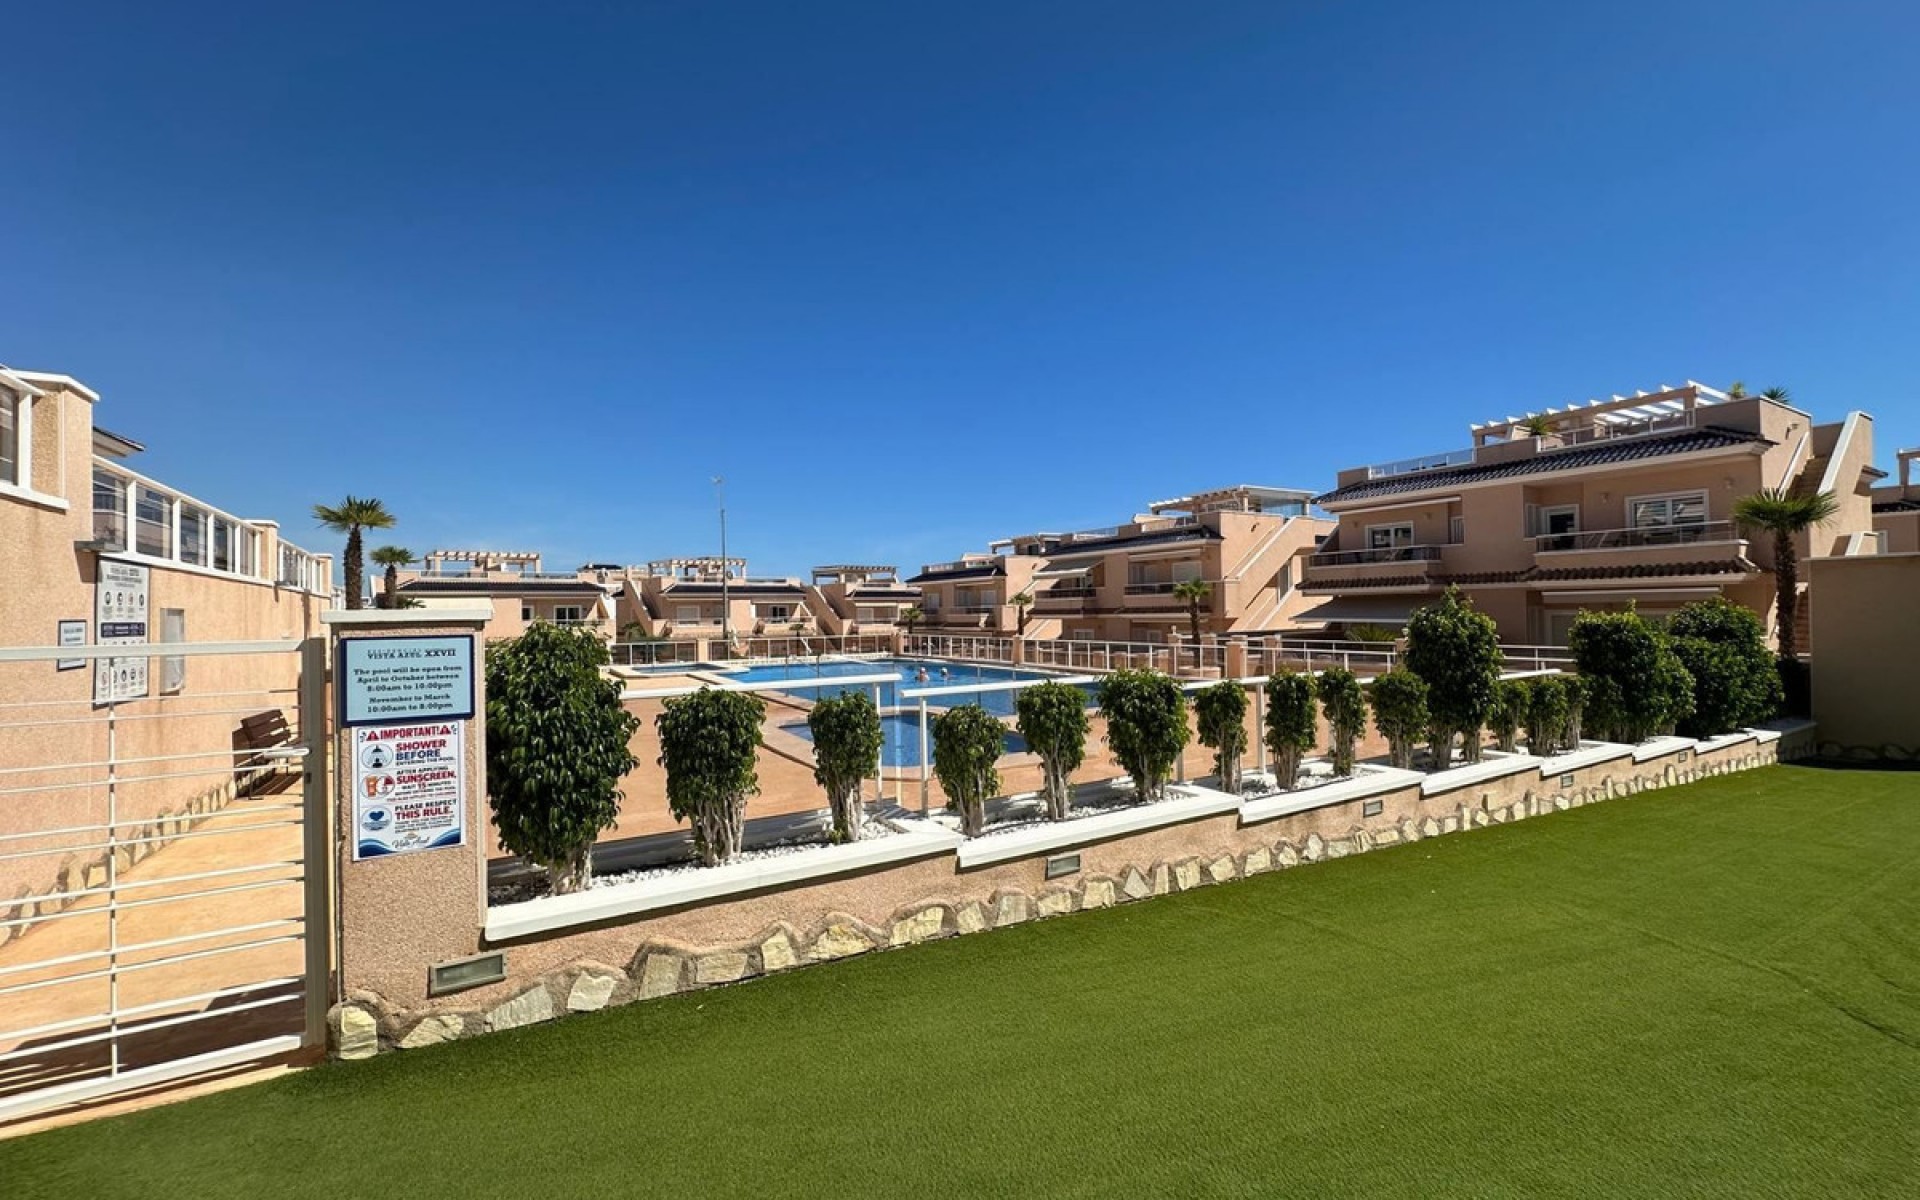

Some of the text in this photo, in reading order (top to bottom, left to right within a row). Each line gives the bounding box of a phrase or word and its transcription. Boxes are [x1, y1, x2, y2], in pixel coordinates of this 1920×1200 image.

[424, 648, 456, 656] XXVII
[415, 682, 453, 690] 10:00pm
[369, 696, 412, 704] November
[367, 705, 406, 713] 10:00am
[380, 726, 440, 739] IMPORTANT!
[396, 739, 446, 751] SHOWER
[396, 749, 440, 760] BEFORE
[395, 799, 457, 811] PLEASE RESPECT
[395, 809, 420, 820] THIS
[424, 805, 453, 816] RULE.
